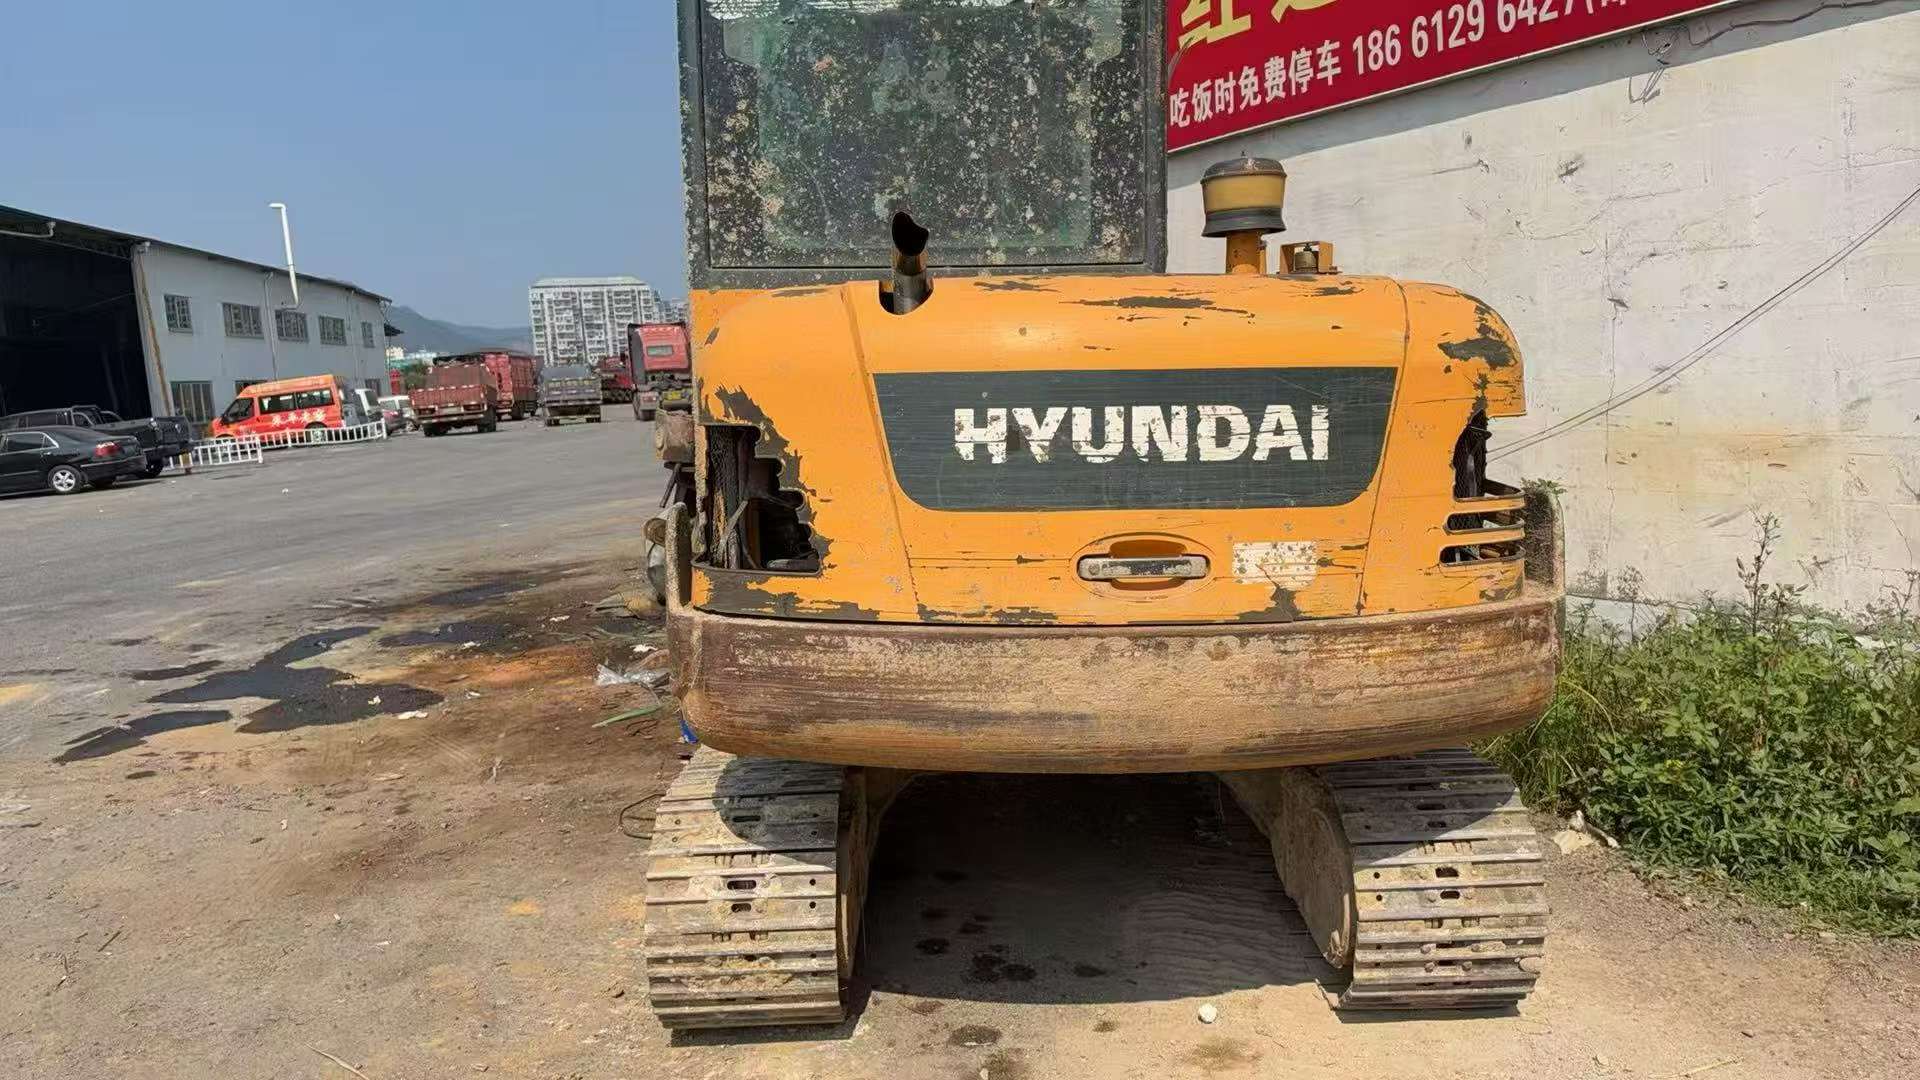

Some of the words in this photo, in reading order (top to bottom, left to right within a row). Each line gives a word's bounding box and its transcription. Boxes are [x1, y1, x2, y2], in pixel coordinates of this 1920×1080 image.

[1170, 40, 1341, 128] 吃饭时免费停车
[1352, 24, 1401, 76] 186
[1411, 0, 1485, 58] 6129
[954, 404, 1329, 463] HYUNDAI
